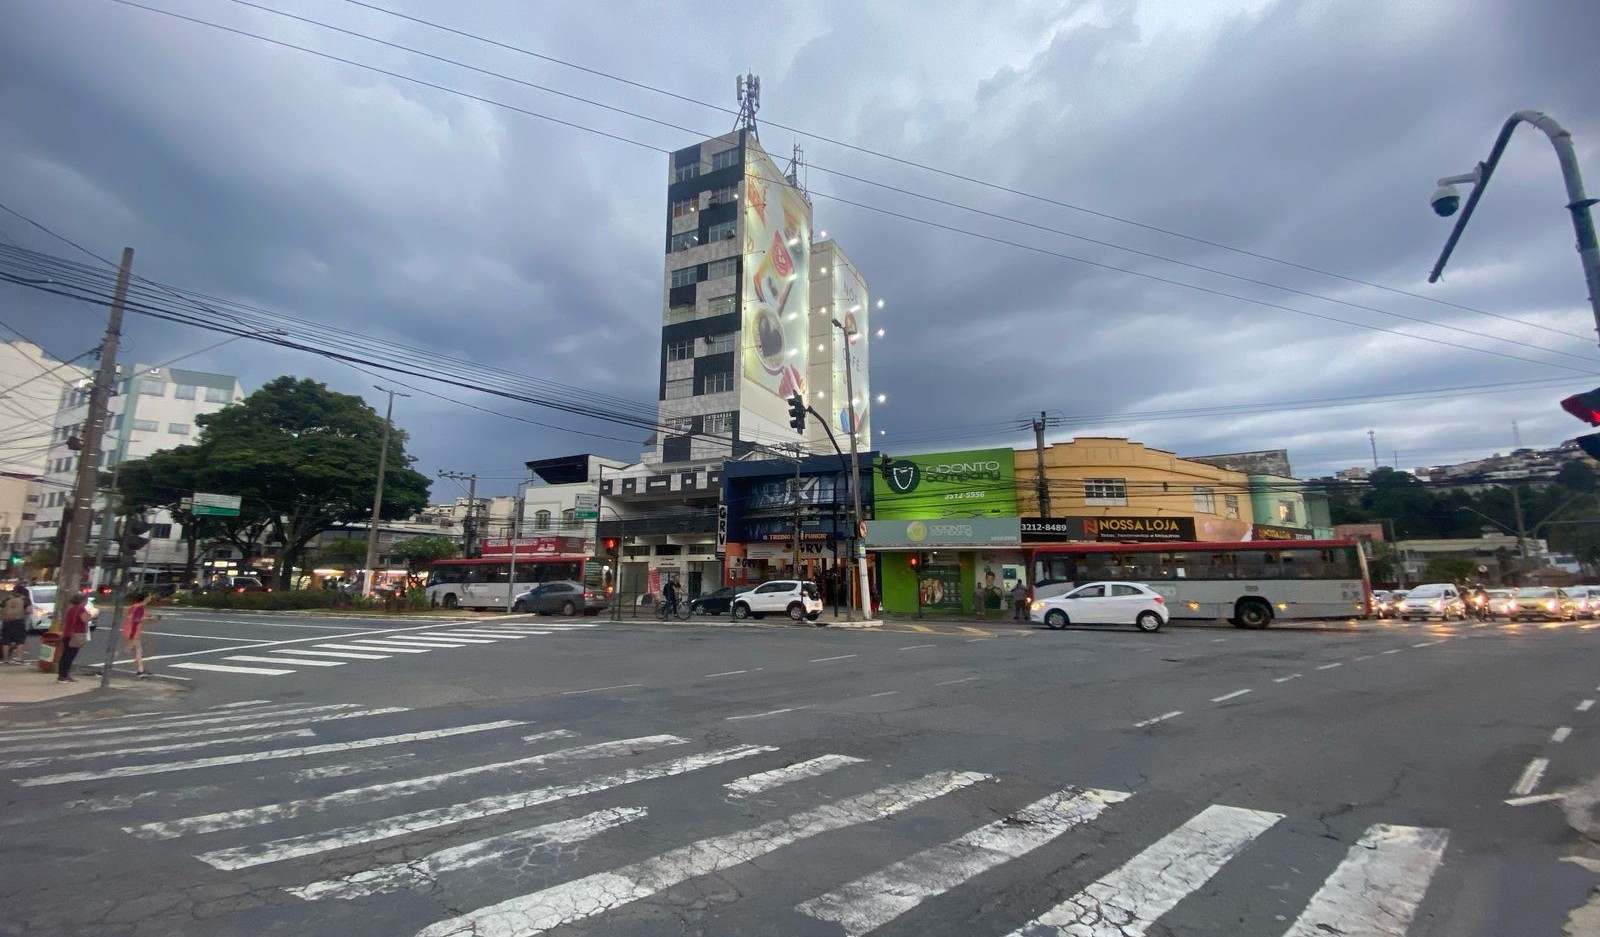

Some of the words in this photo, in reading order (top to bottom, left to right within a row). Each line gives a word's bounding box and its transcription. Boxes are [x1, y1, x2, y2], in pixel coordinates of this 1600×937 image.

[926, 461, 1000, 475] ODONTO
[719, 506, 727, 546] GRV
[1021, 523, 1067, 531] 3212-8489
[1099, 519, 1144, 531] NOSSA
[1146, 519, 1180, 531] LOJA
